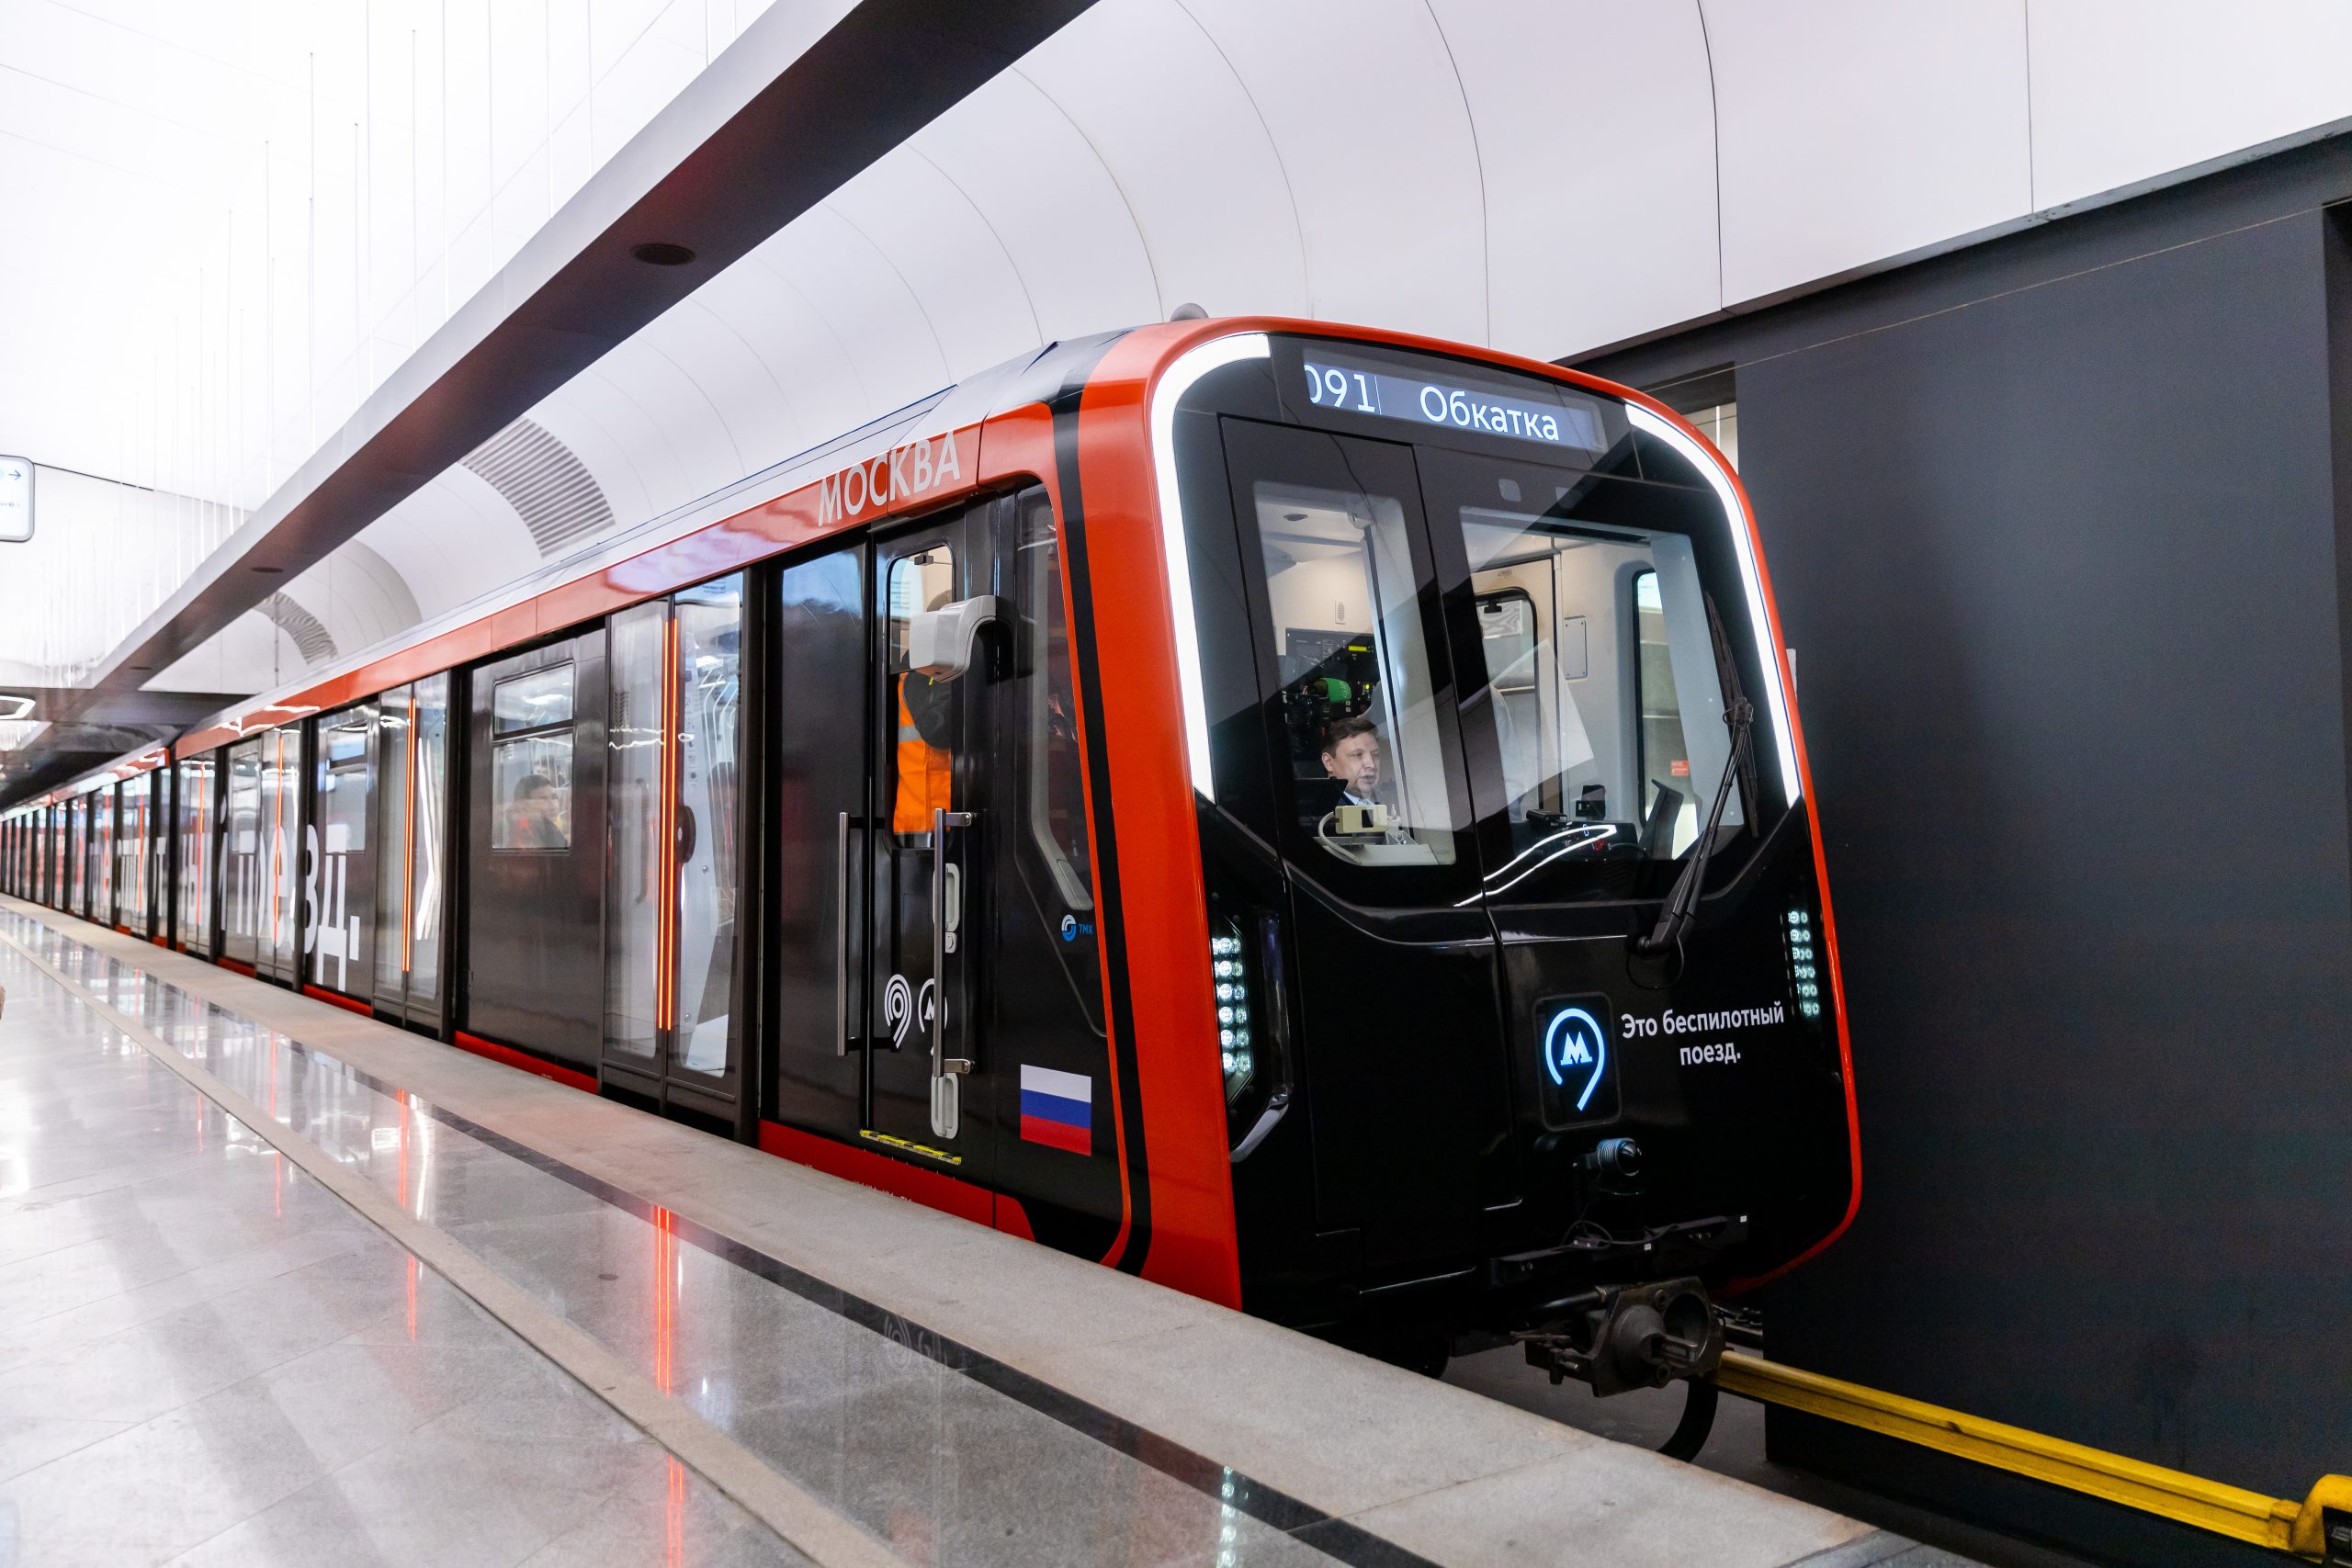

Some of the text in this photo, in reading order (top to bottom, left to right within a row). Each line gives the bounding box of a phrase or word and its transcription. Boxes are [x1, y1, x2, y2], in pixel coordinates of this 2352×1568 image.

[1419, 385, 1560, 441] Обкатка
[818, 429, 961, 527] МОСКВА
[1621, 999, 1785, 1039] Это беспилотный
[1679, 1042, 1742, 1066] поезд.
